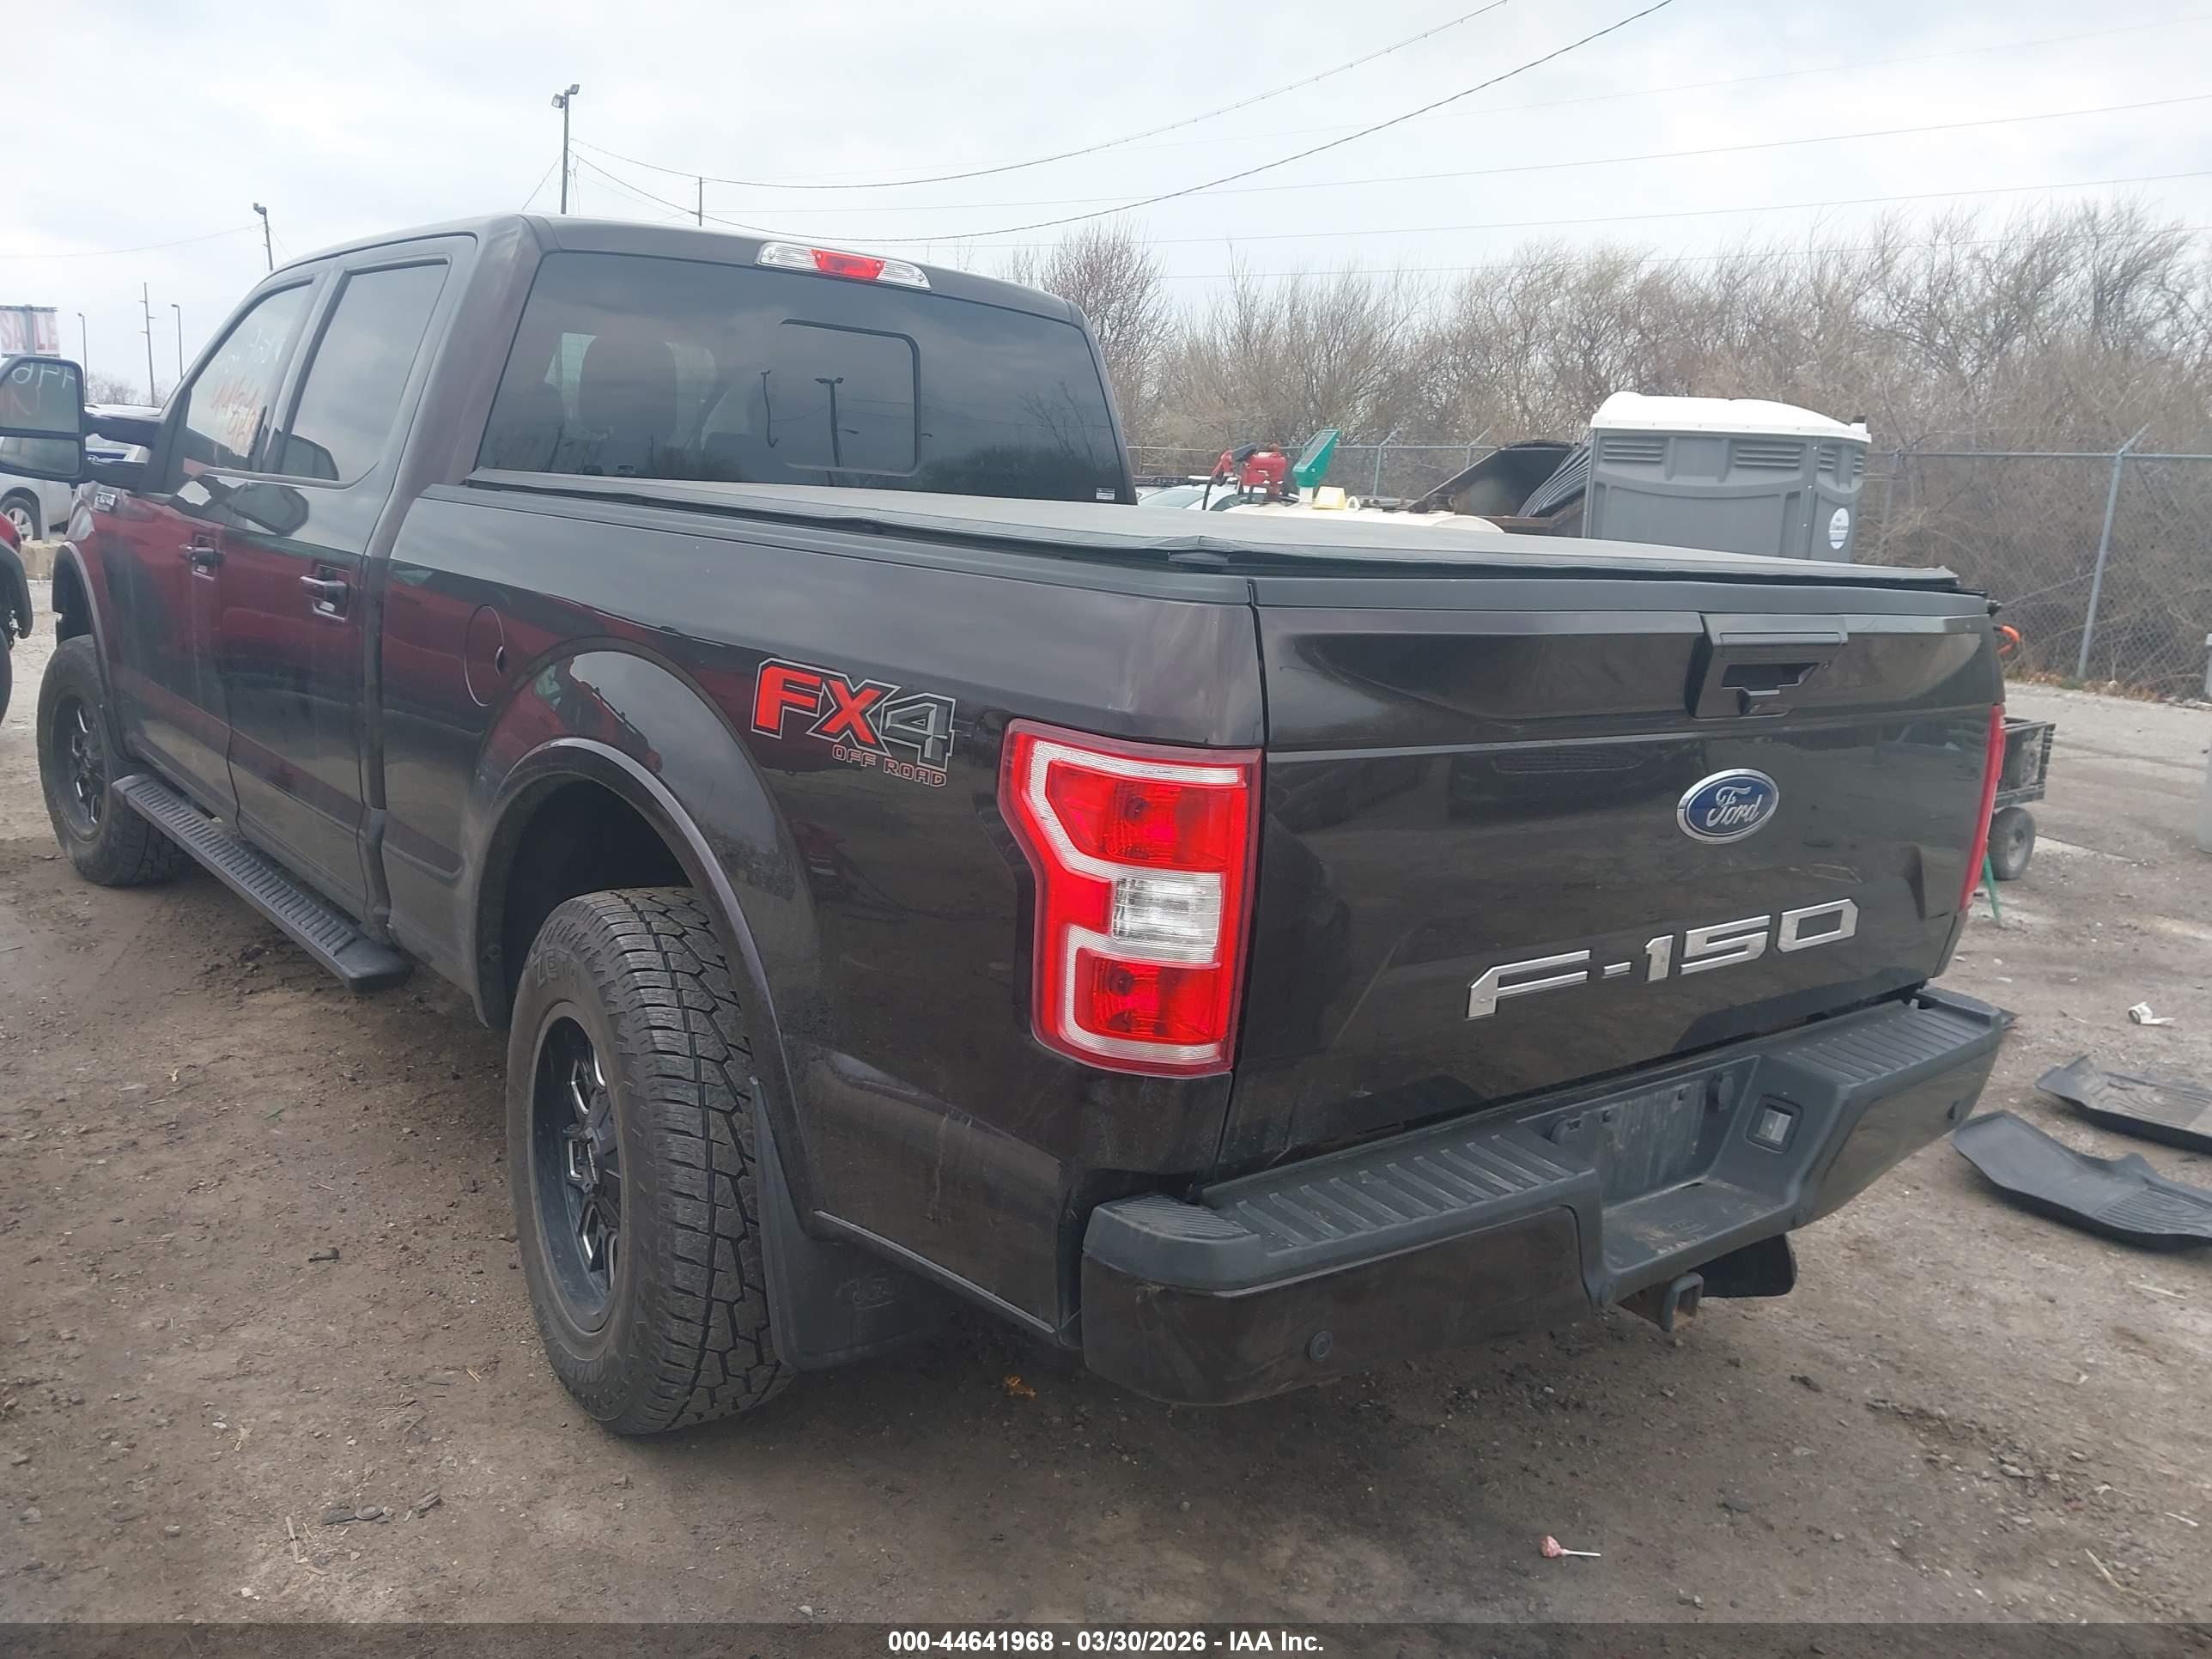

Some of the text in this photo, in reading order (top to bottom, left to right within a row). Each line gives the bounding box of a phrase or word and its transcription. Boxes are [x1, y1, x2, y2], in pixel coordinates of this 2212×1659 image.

[0, 312, 57, 350] SALE
[750, 657, 957, 772] FX4
[832, 744, 947, 787] OFF ROAD
[1706, 786, 1763, 827] Ford
[1466, 897, 1859, 1018] F-150
